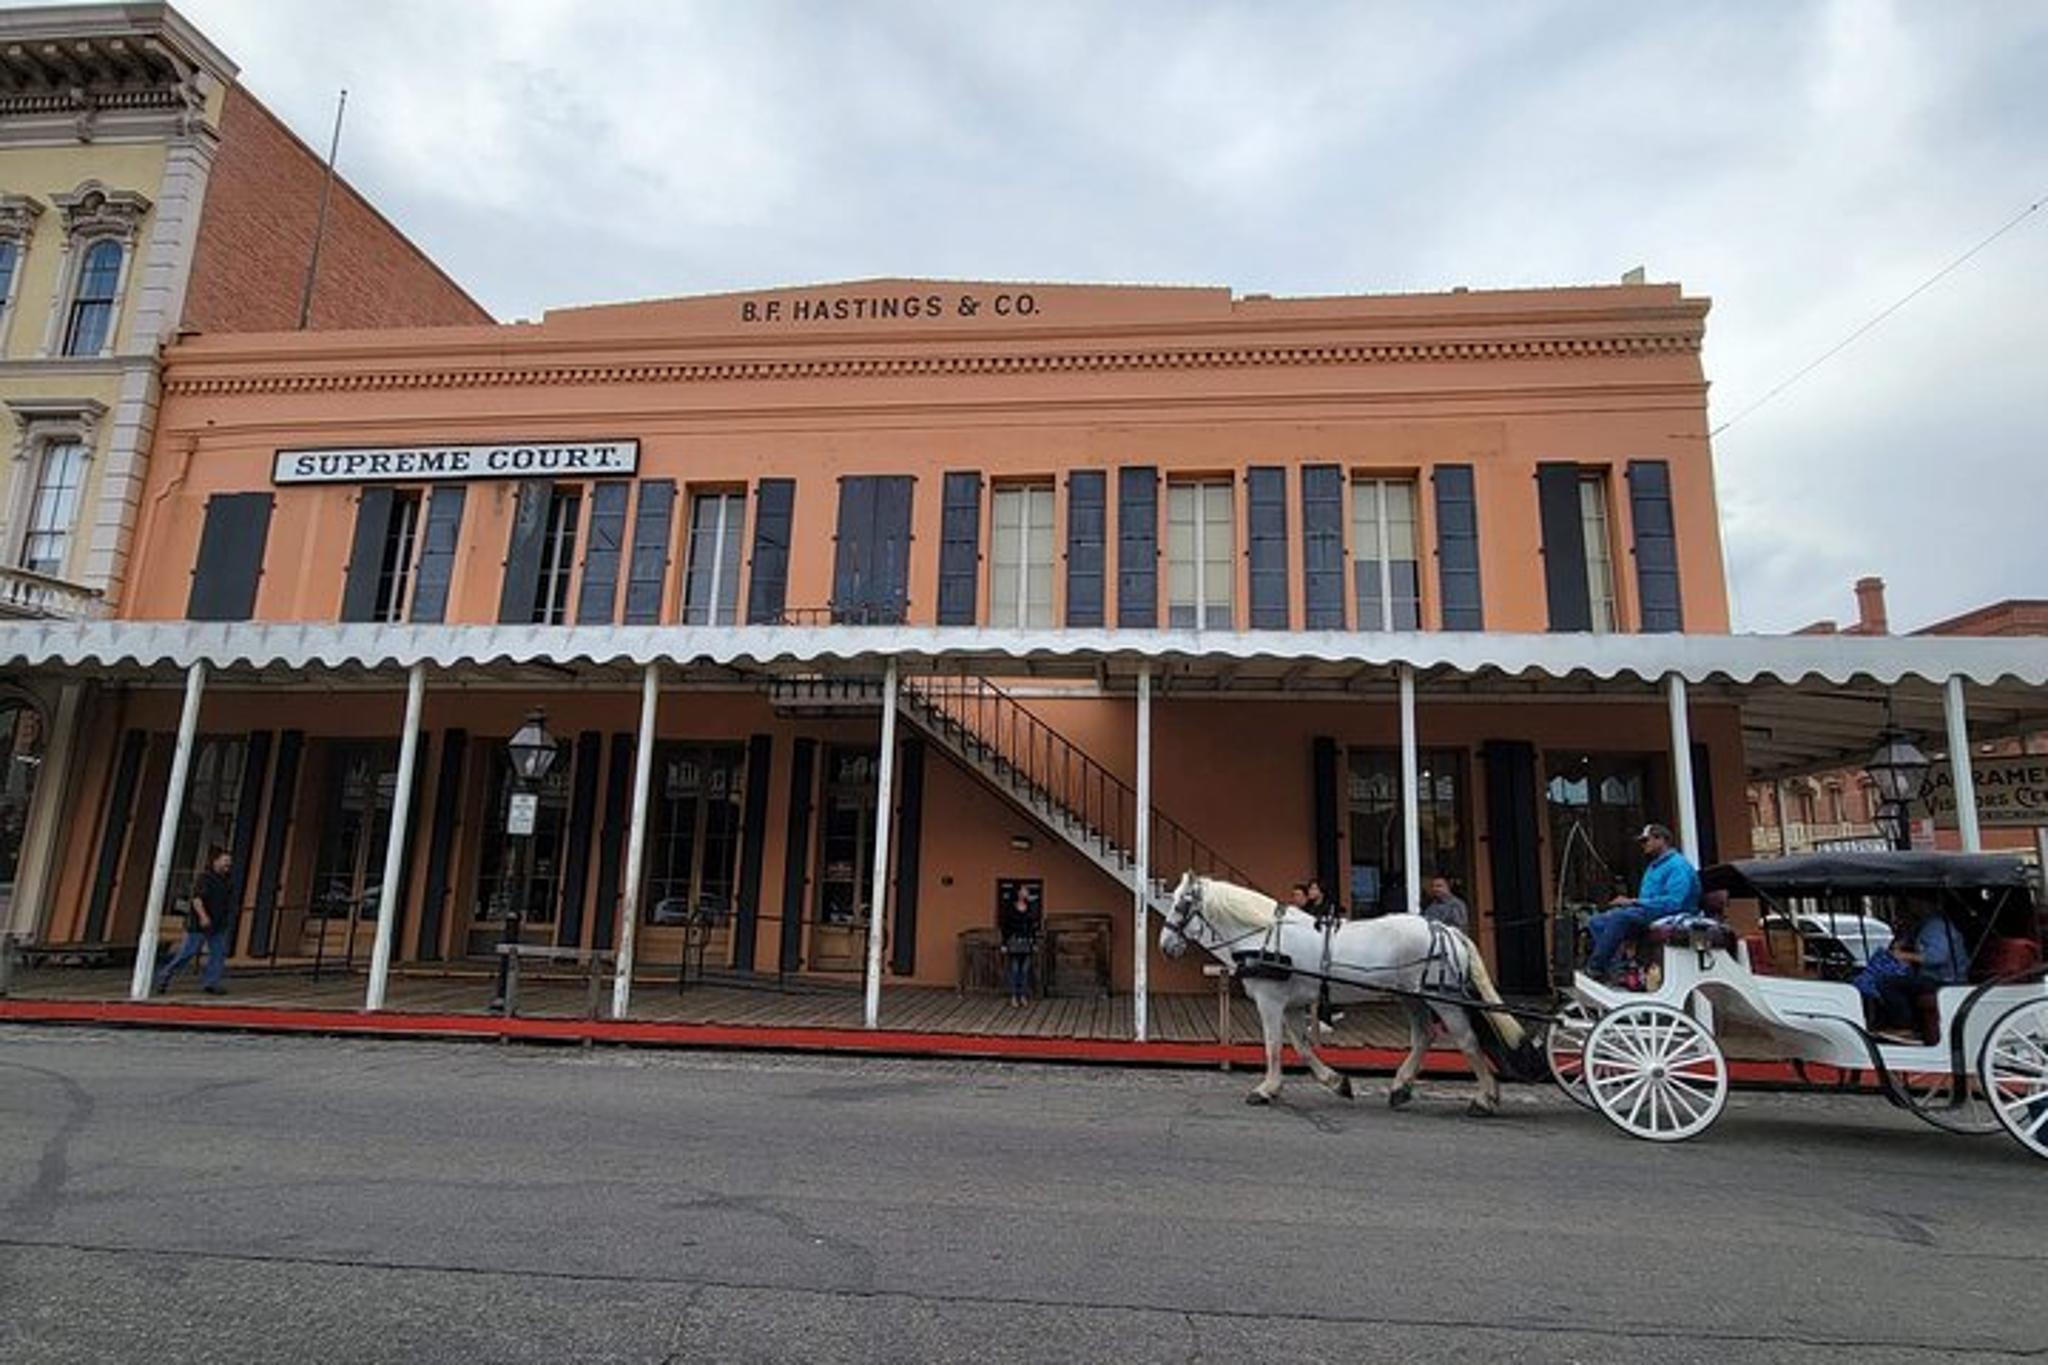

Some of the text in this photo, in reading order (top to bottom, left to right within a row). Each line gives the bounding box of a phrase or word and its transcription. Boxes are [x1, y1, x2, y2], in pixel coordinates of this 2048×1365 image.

[742, 294, 1040, 322] B.F. HASTINGS & CO.
[294, 447, 622, 476] SUPREME COURT.
